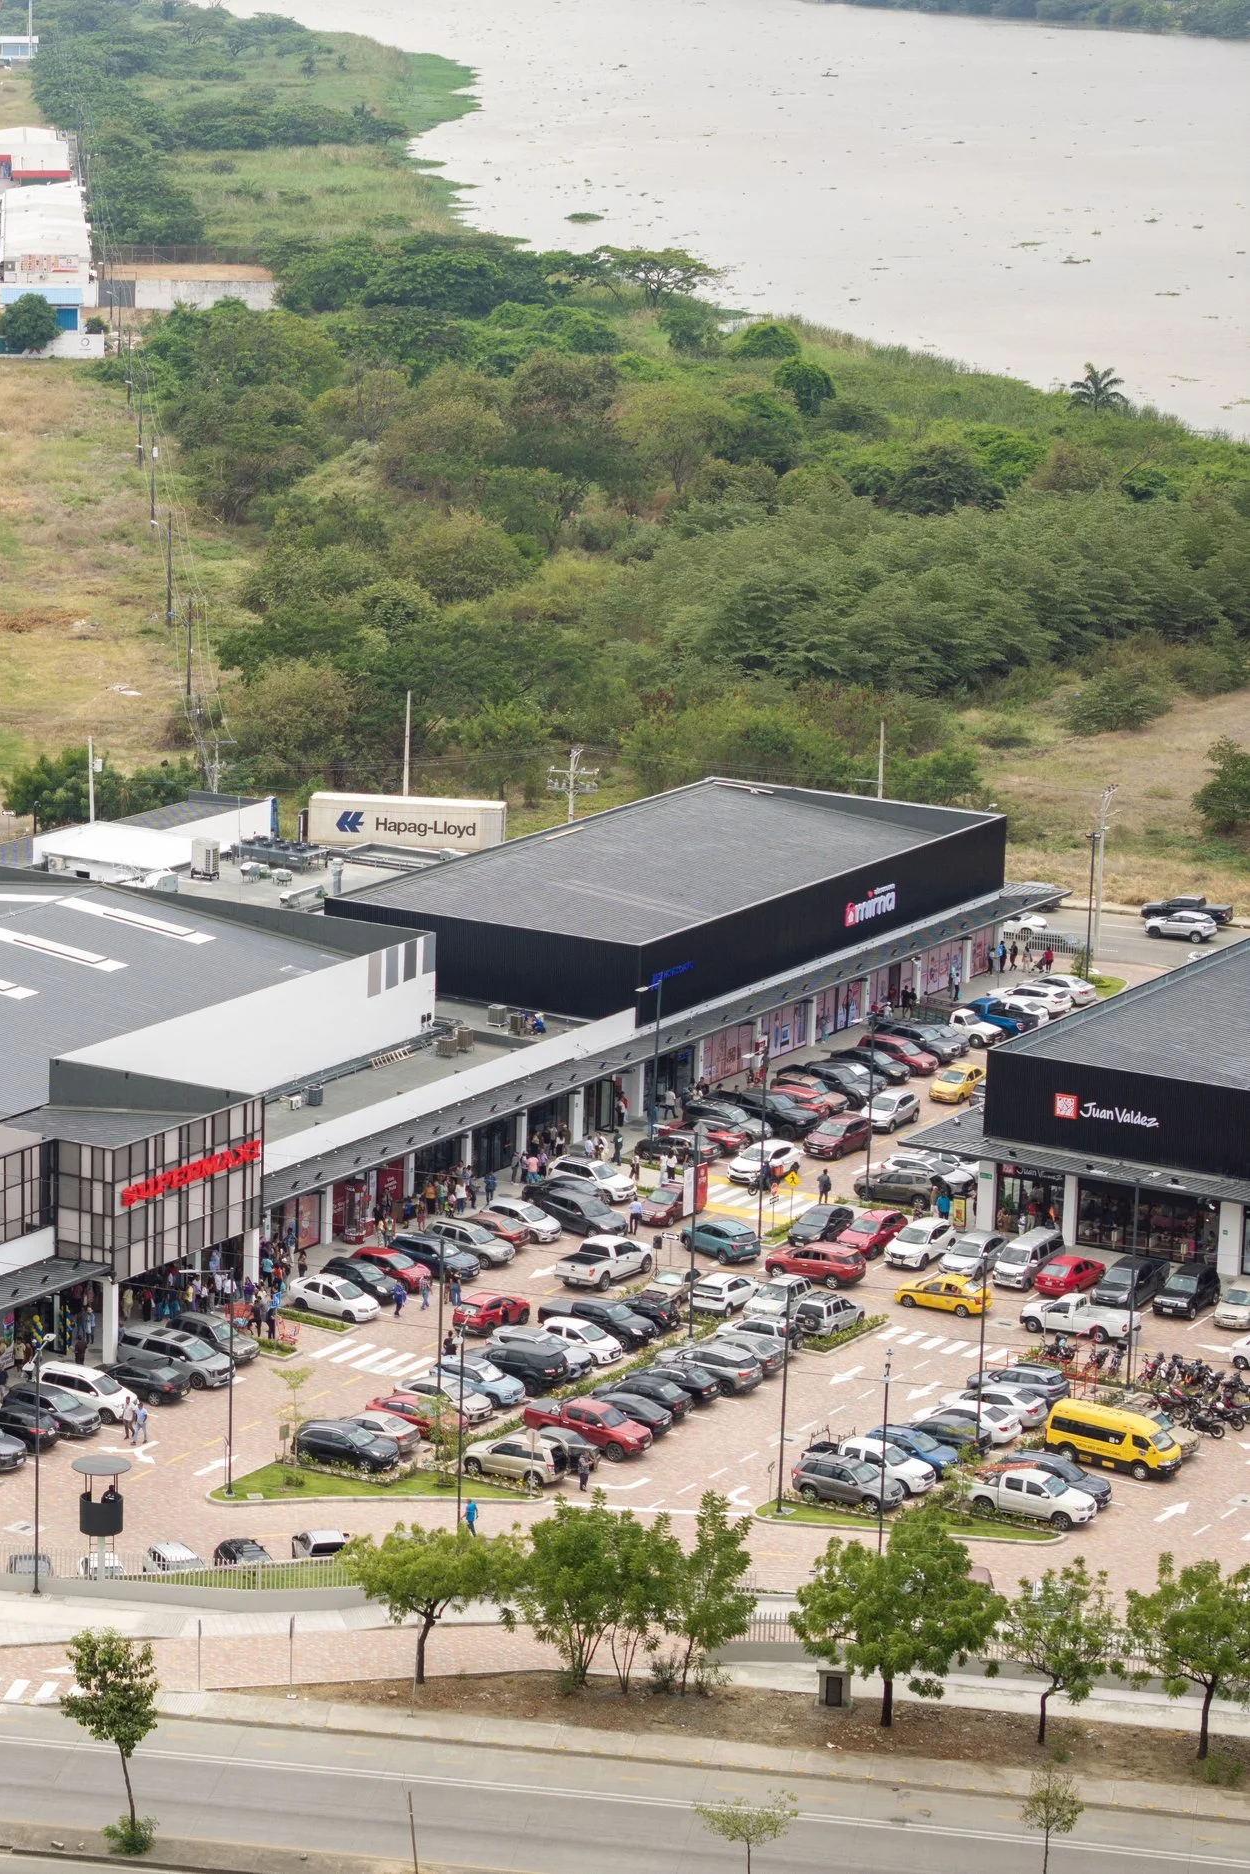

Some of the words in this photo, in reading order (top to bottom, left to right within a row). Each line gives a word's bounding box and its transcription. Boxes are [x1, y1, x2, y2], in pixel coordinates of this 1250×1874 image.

[375, 817, 476, 838] Hapag-Lloyd
[1079, 1102, 1114, 1120] Juan
[1115, 1107, 1159, 1128] Valdez
[121, 1139, 261, 1207] SUPERMAXI
